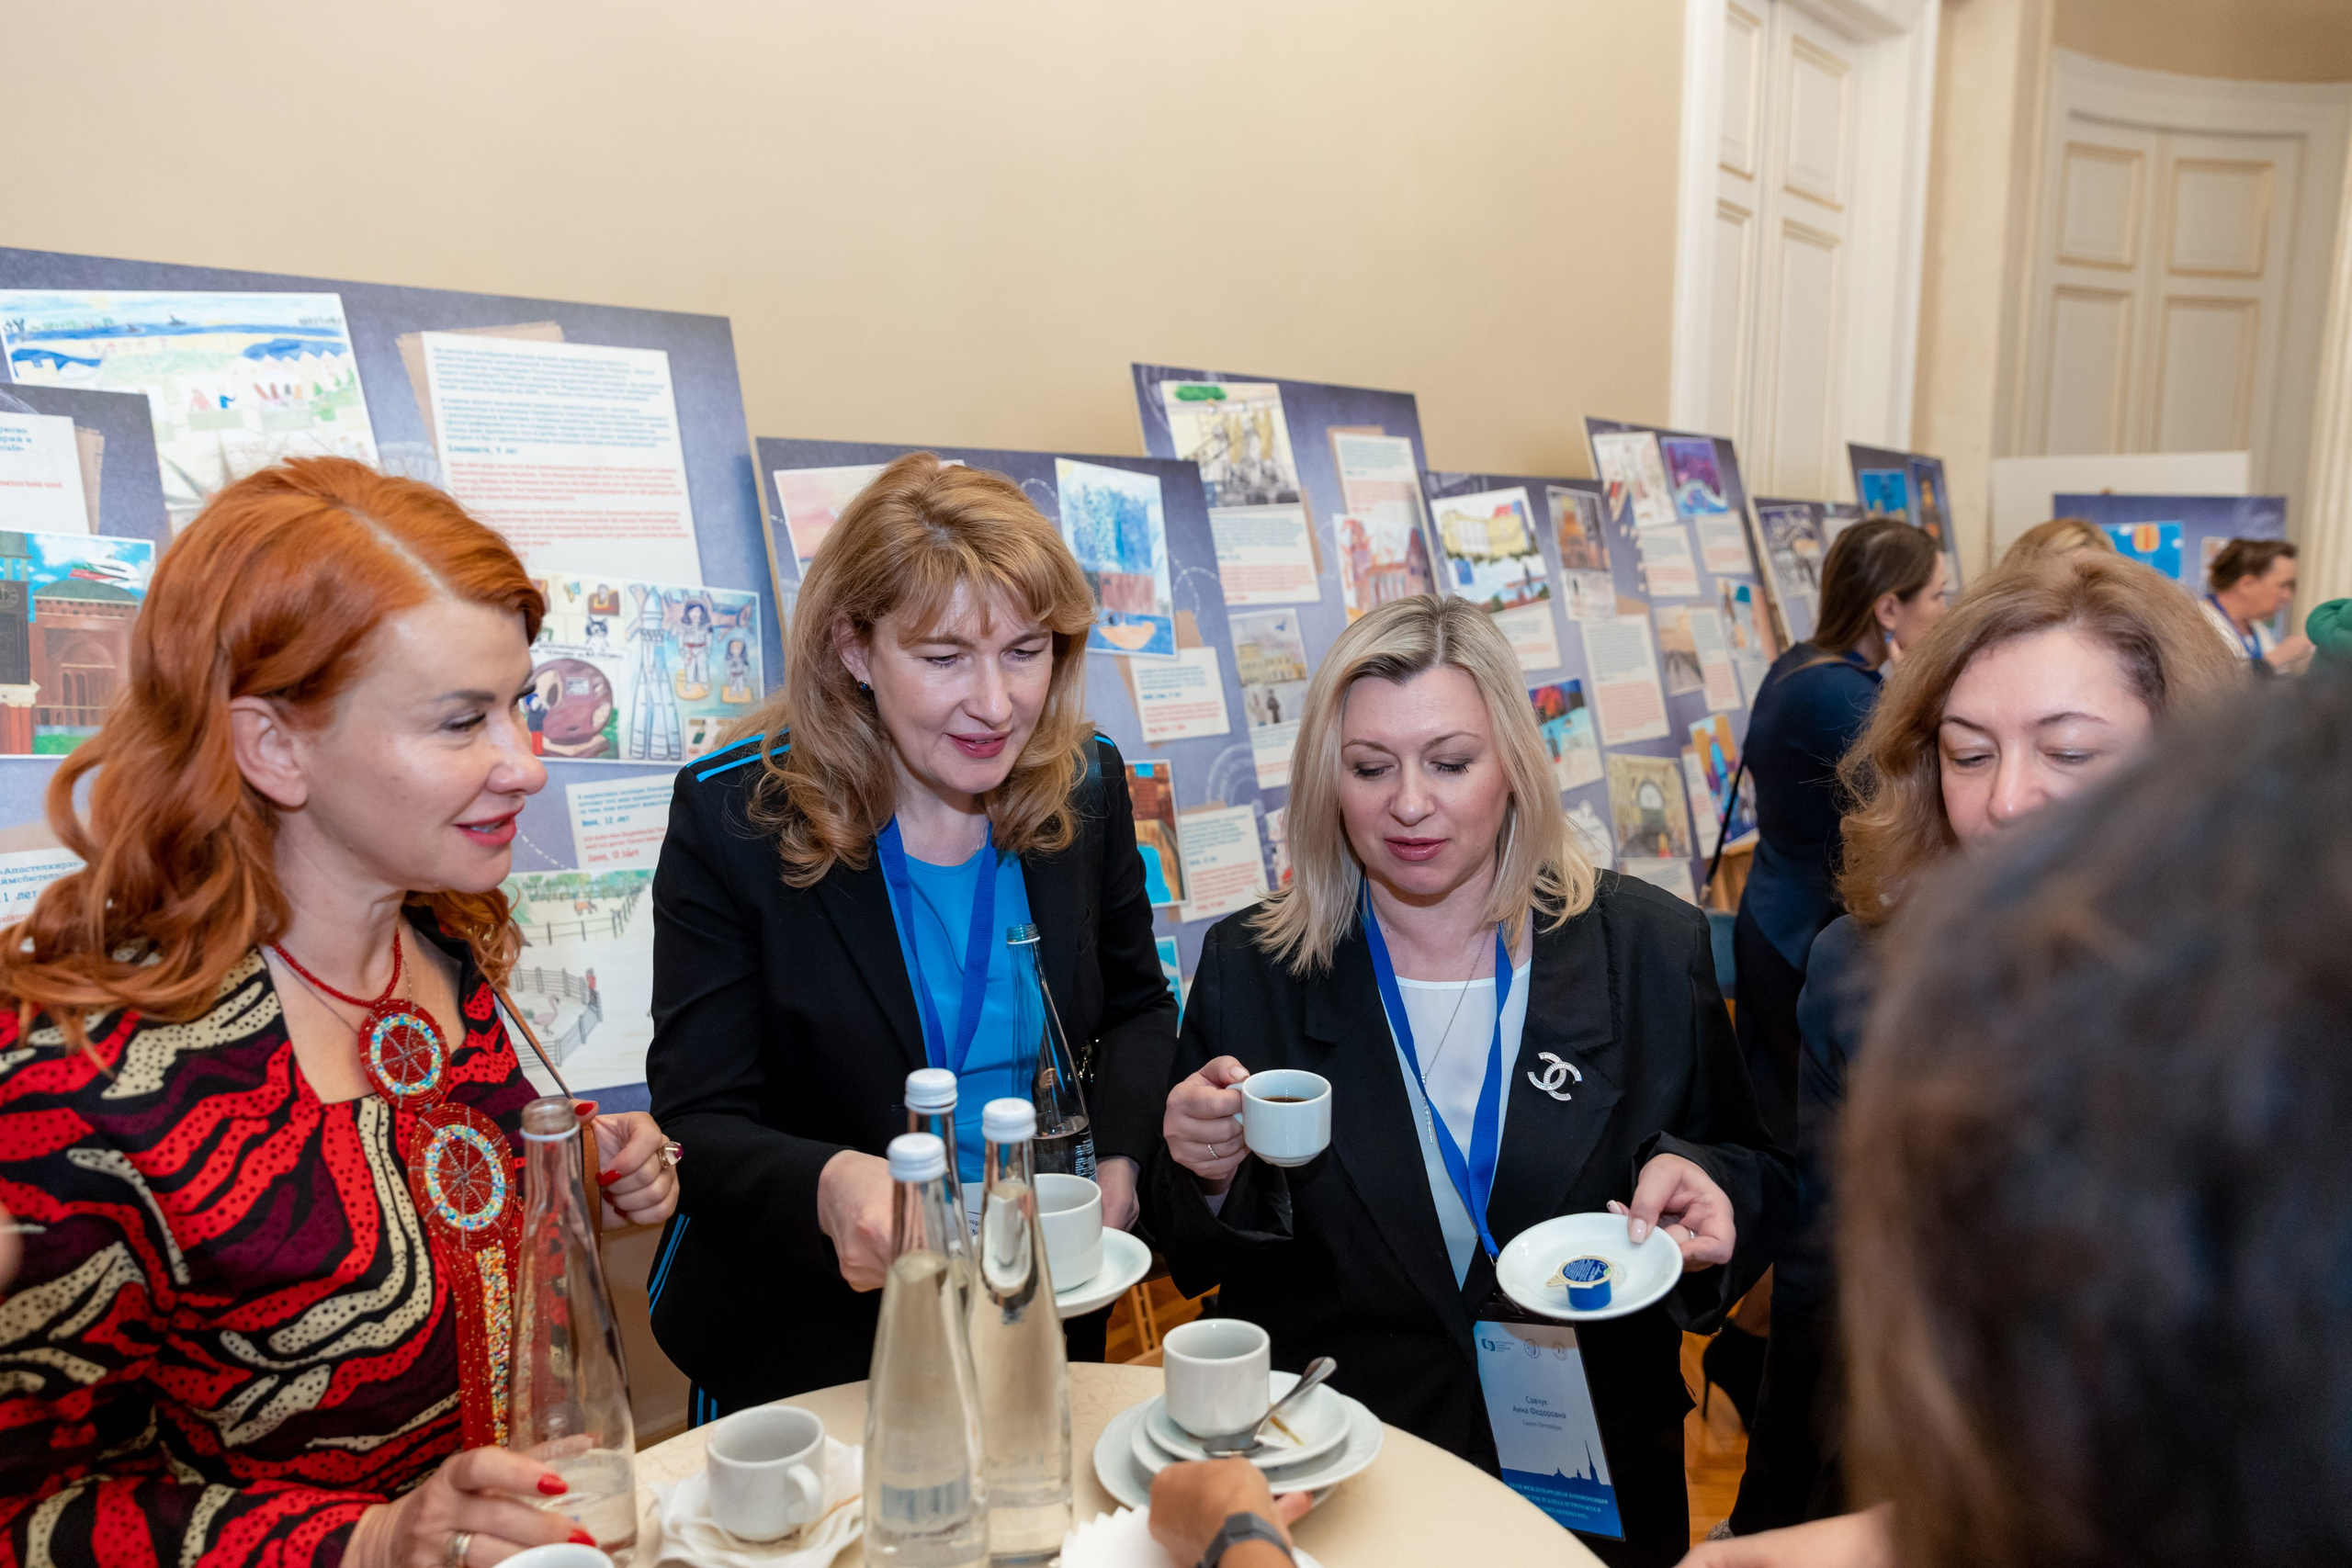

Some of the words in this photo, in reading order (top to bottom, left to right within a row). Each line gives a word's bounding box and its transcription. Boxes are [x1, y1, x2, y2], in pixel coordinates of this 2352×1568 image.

[16, 890, 37, 900] лет
[1525, 1395, 1548, 1406] Савчук
[1512, 1404, 1529, 1414] Анна
[1530, 1406, 1566, 1419] Федоровна
[1522, 1484, 1568, 1497] МЕЖДУНАРОДНАЯ
[1568, 1492, 1609, 1505] КОНФЕРЕНЦИЯ
